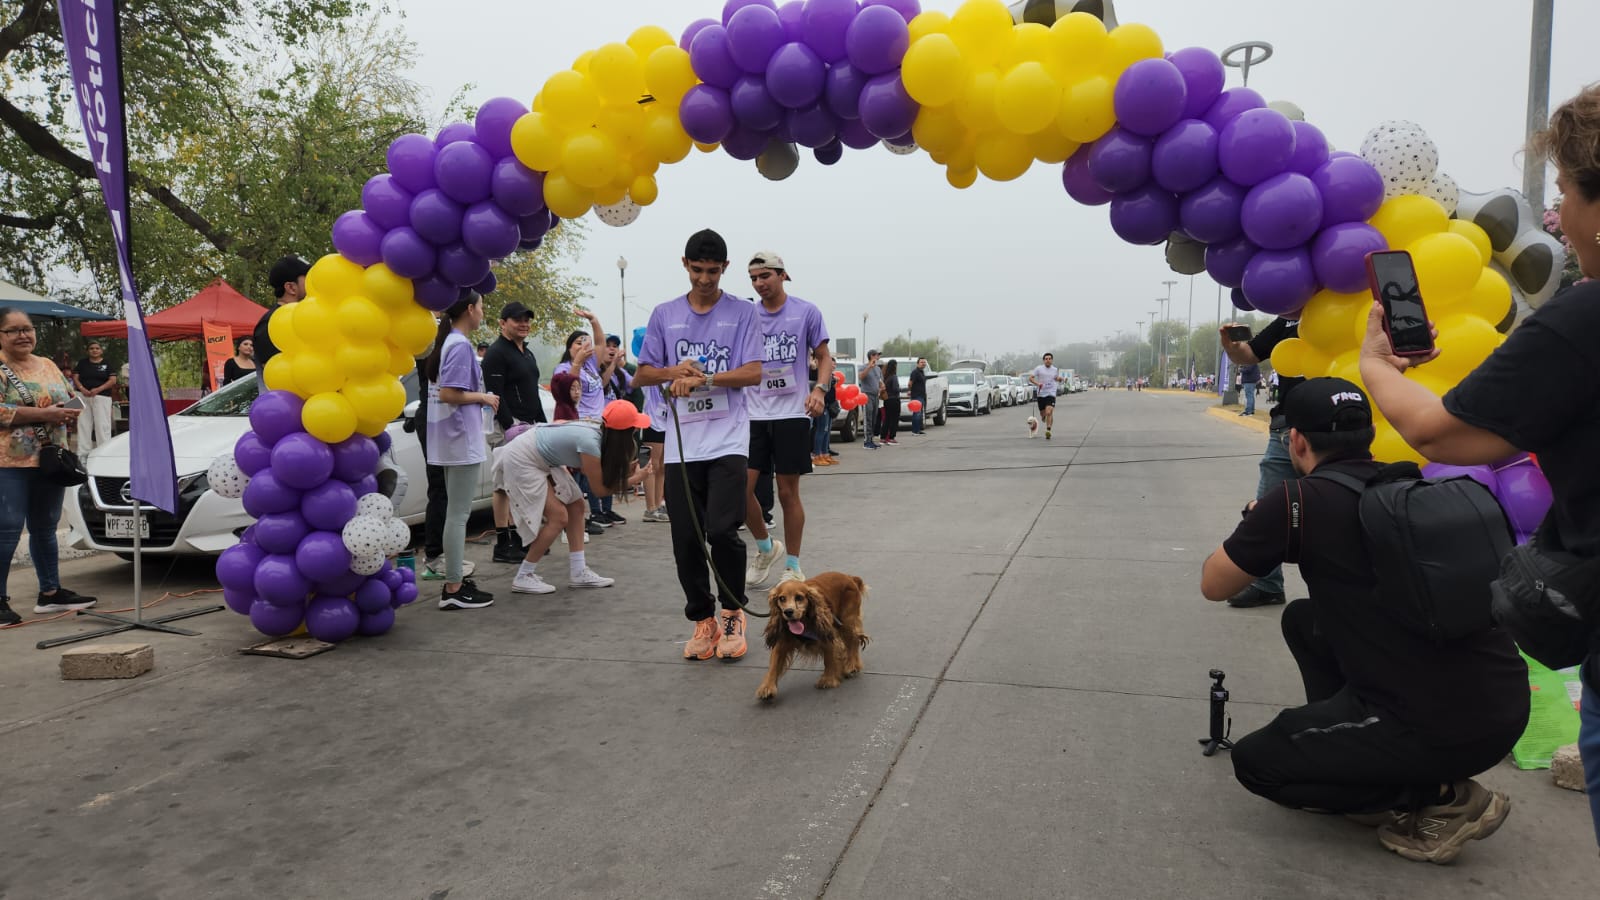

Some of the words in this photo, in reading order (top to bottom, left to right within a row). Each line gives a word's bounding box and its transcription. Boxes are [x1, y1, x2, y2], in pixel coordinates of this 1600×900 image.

[767, 379, 786, 389] 043
[688, 398, 713, 413] 205
[107, 518, 147, 532] VPF-32-B
